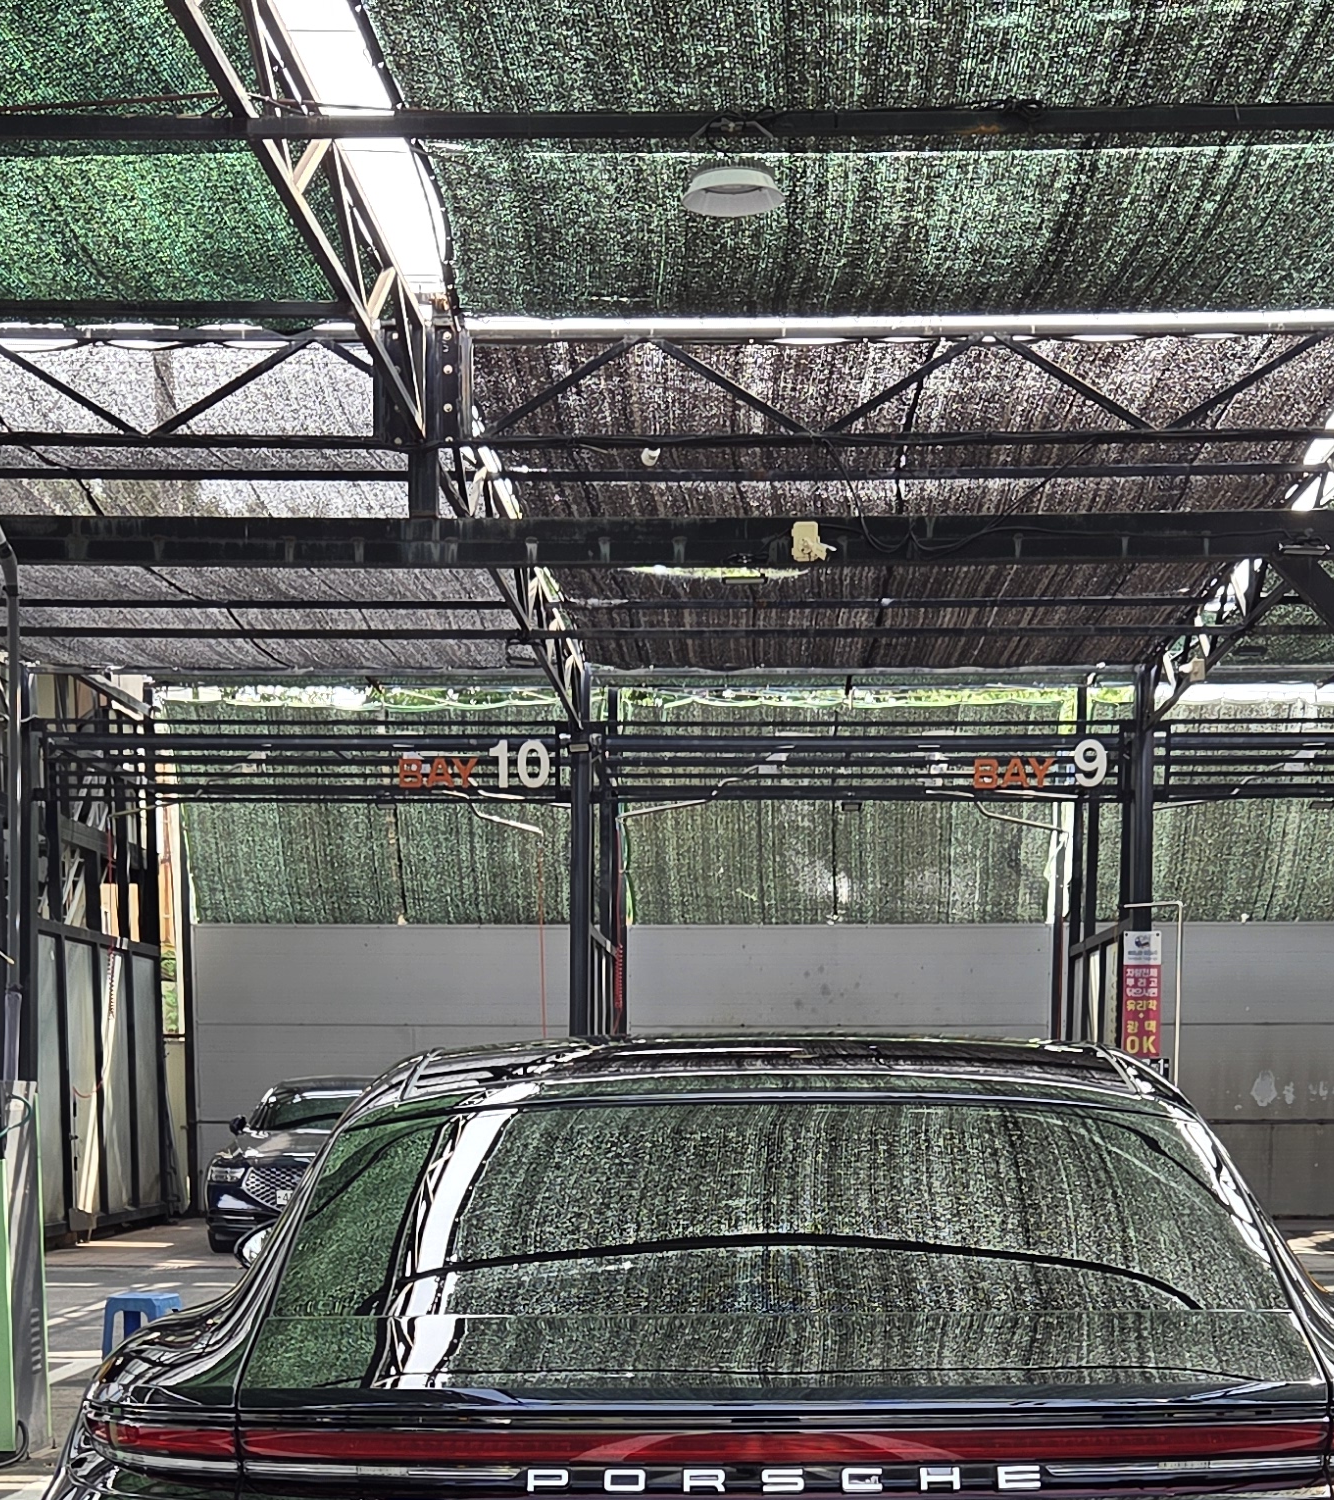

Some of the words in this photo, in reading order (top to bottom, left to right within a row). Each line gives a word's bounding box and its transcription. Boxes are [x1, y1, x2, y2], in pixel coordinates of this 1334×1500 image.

[398, 756, 478, 788] BAY
[489, 739, 550, 788] 10
[973, 757, 1057, 788] BAY
[1074, 739, 1107, 787] 9
[1126, 1036, 1156, 1054] OK
[526, 1464, 1043, 1493] PORSCHE
